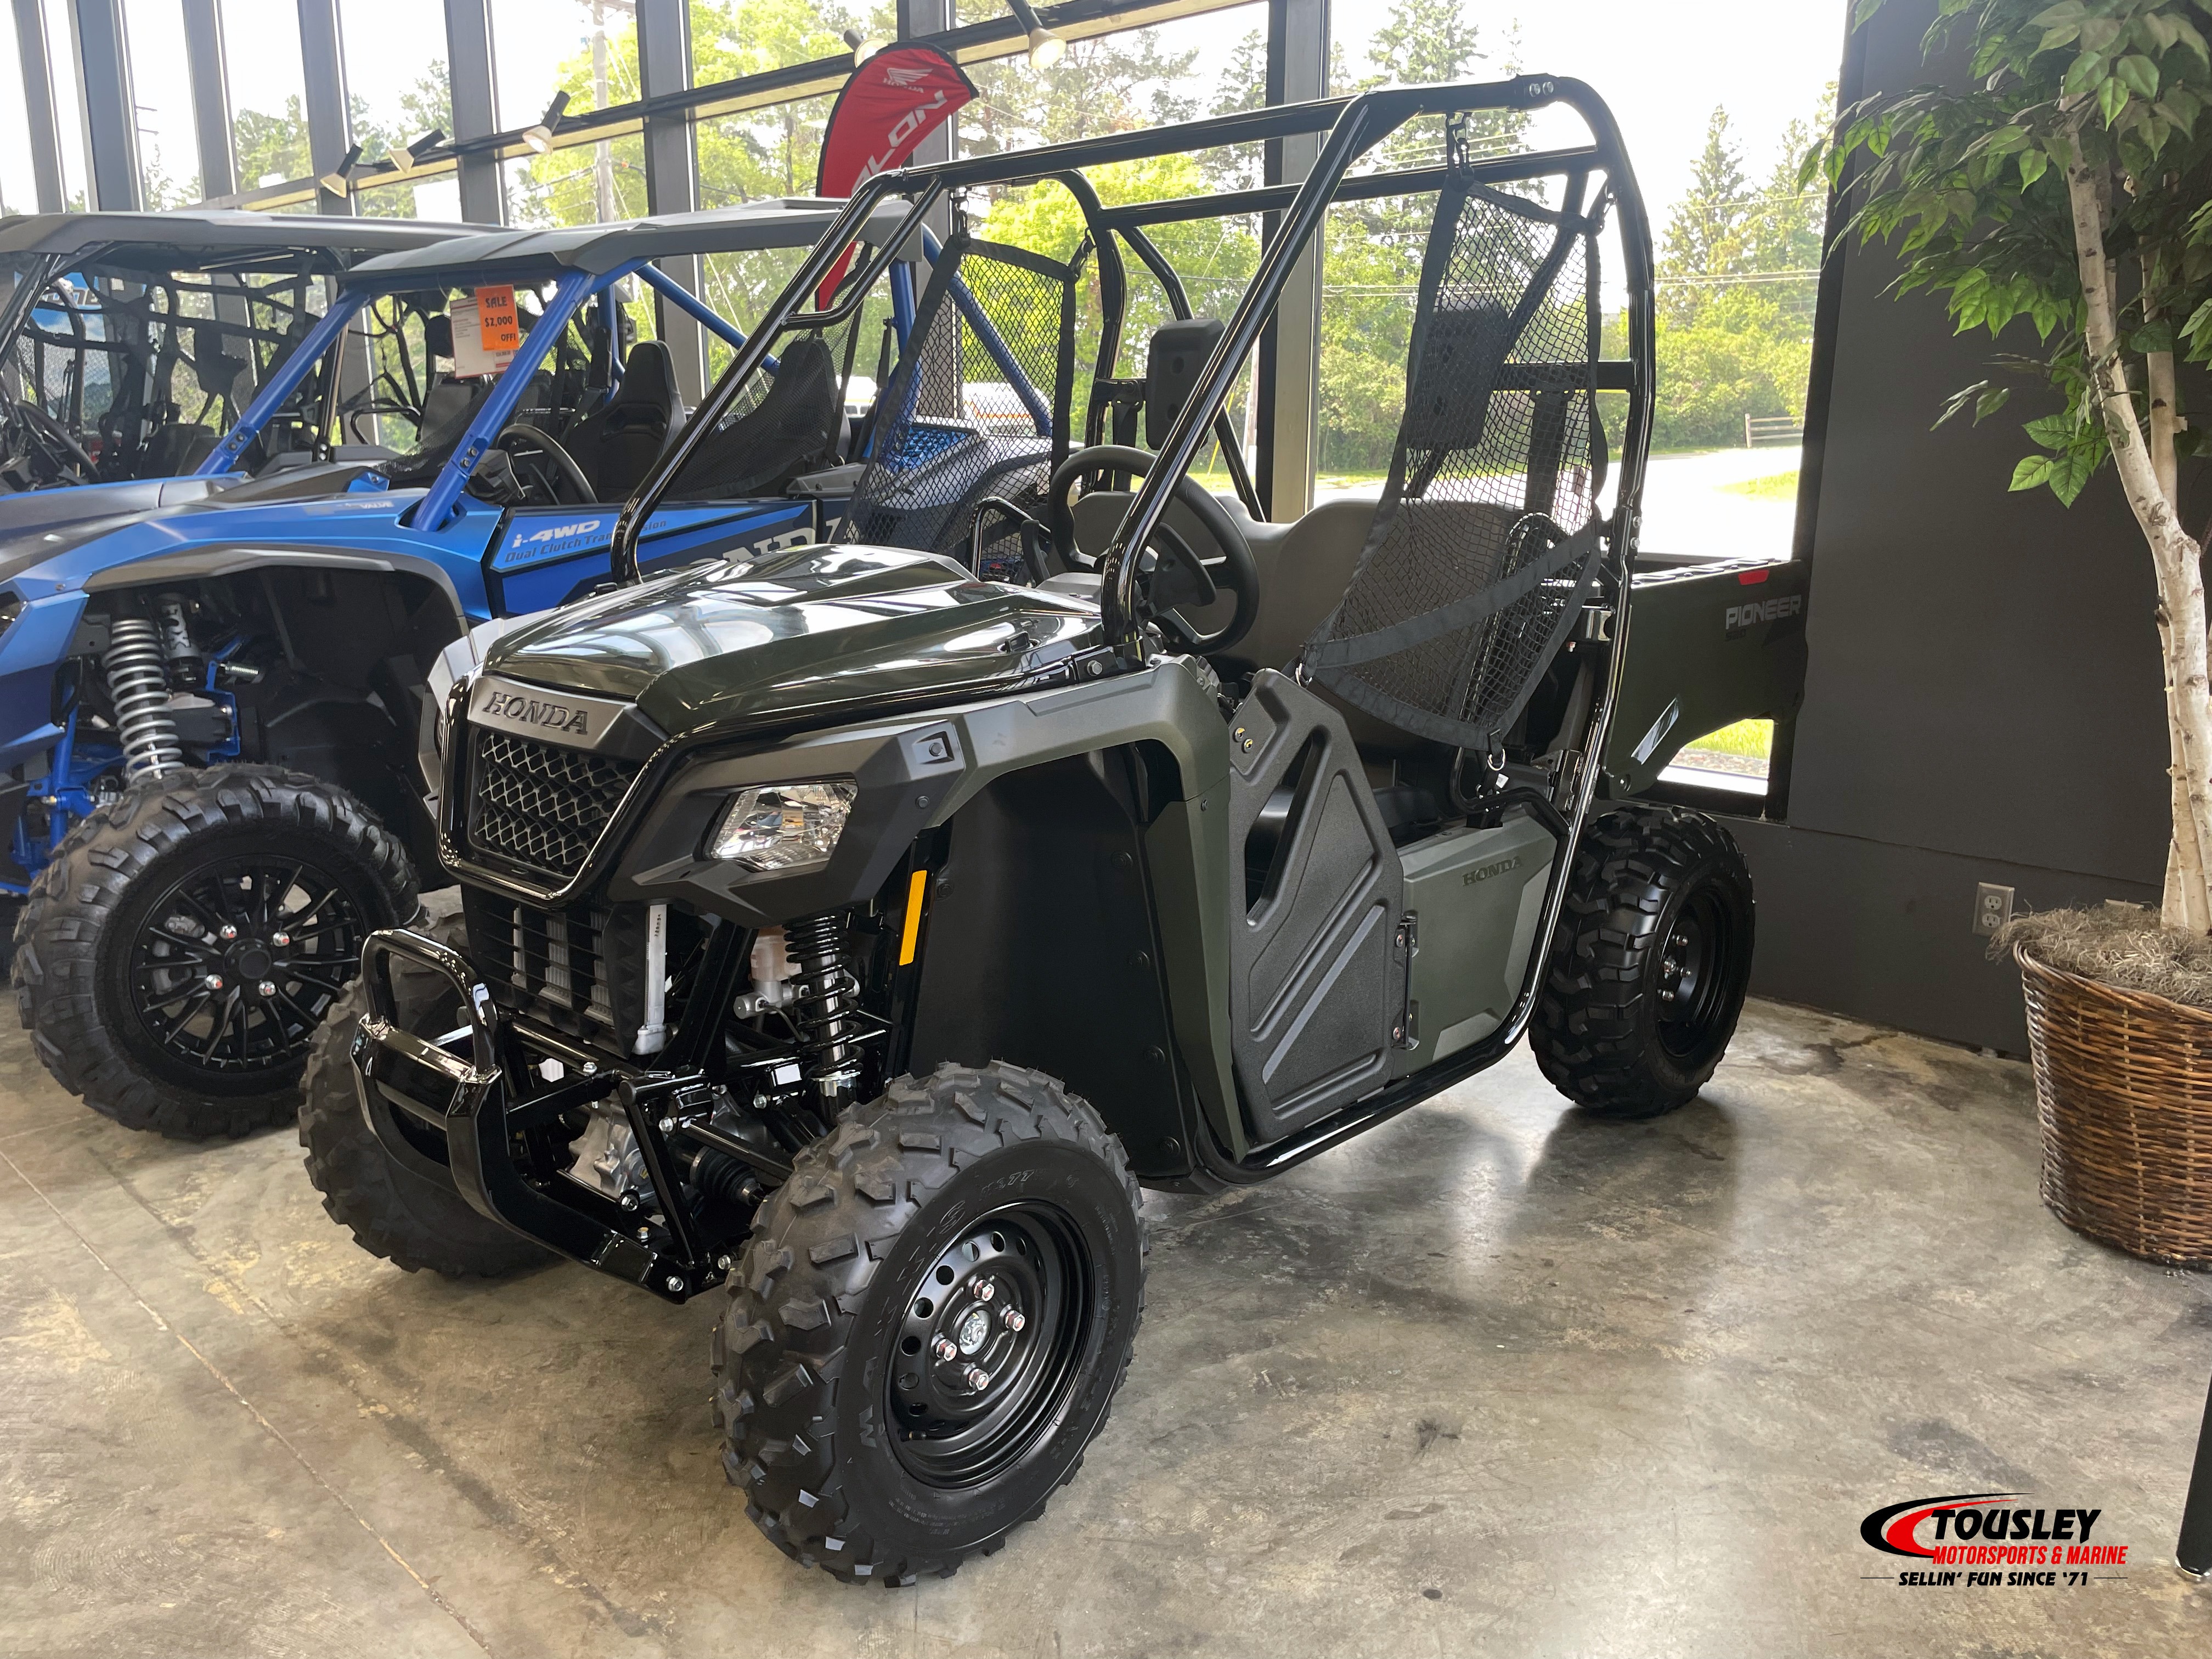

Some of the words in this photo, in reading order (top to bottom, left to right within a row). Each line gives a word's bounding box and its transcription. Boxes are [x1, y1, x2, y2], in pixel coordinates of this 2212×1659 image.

[883, 78, 924, 94] HODA
[486, 297, 507, 308] SALE
[485, 316, 512, 327] $2,000
[505, 548, 536, 563] Dual
[540, 538, 581, 555] Clutch
[584, 519, 667, 545] Transion
[512, 520, 600, 549] i-4WD
[1726, 595, 1801, 629] PIONEER
[482, 692, 588, 734] HONDA
[1462, 856, 1523, 885] HONDA
